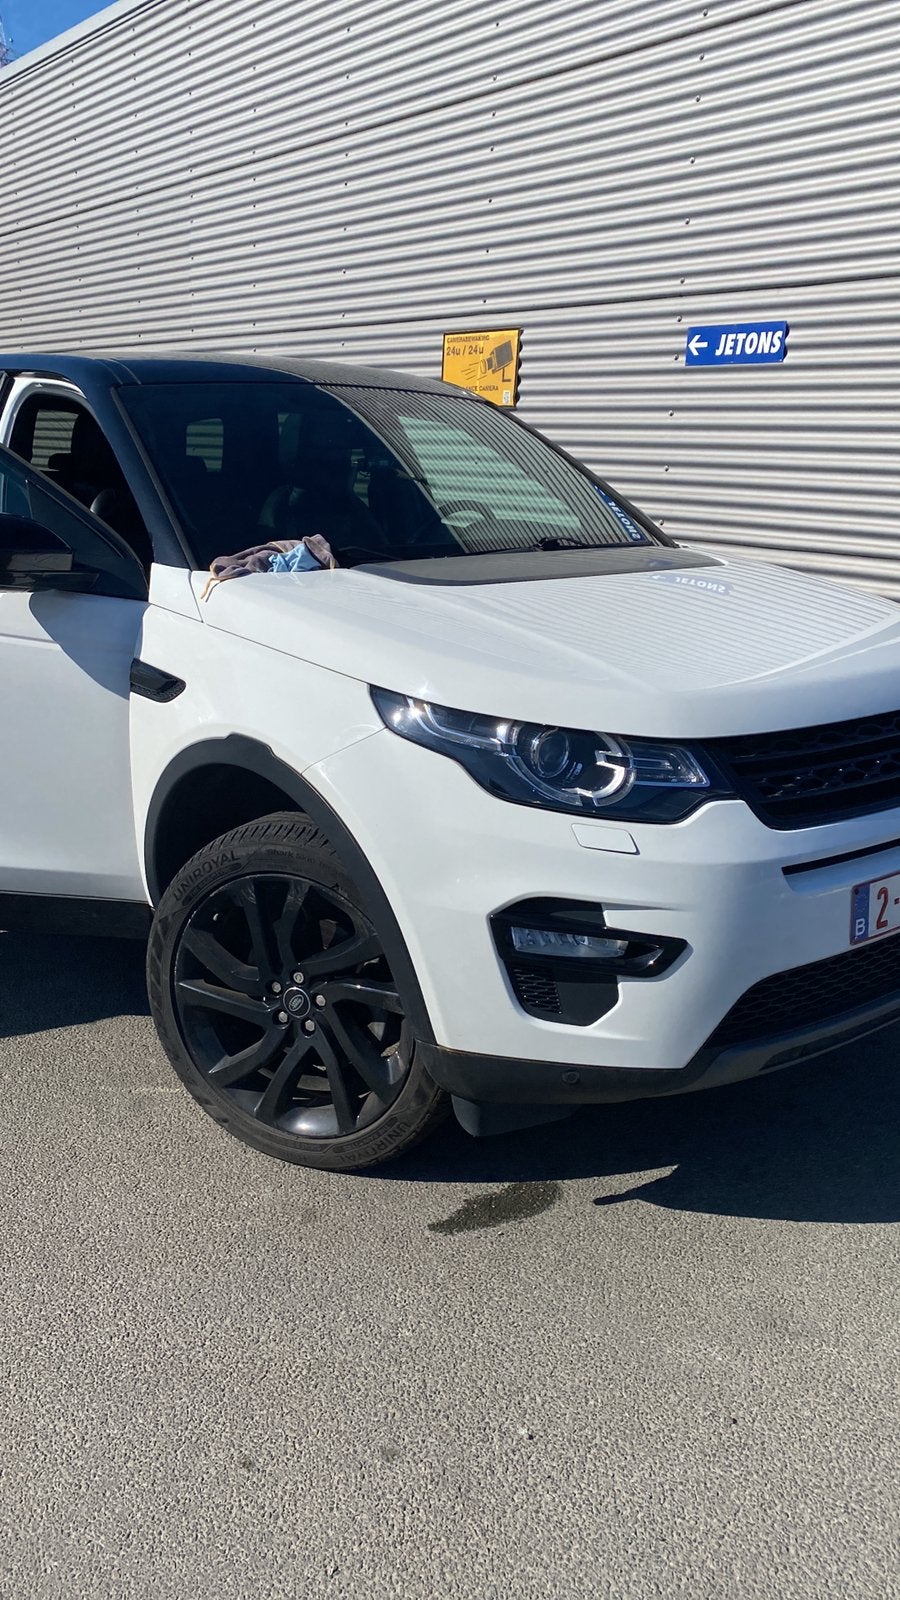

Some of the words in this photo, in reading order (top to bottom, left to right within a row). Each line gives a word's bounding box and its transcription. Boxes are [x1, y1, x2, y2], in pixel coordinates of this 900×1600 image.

[446, 346, 461, 356] 24u
[468, 344, 484, 355] 24u
[715, 331, 784, 356] JETONS
[173, 850, 241, 901] UNIROYAL
[856, 918, 865, 936] B
